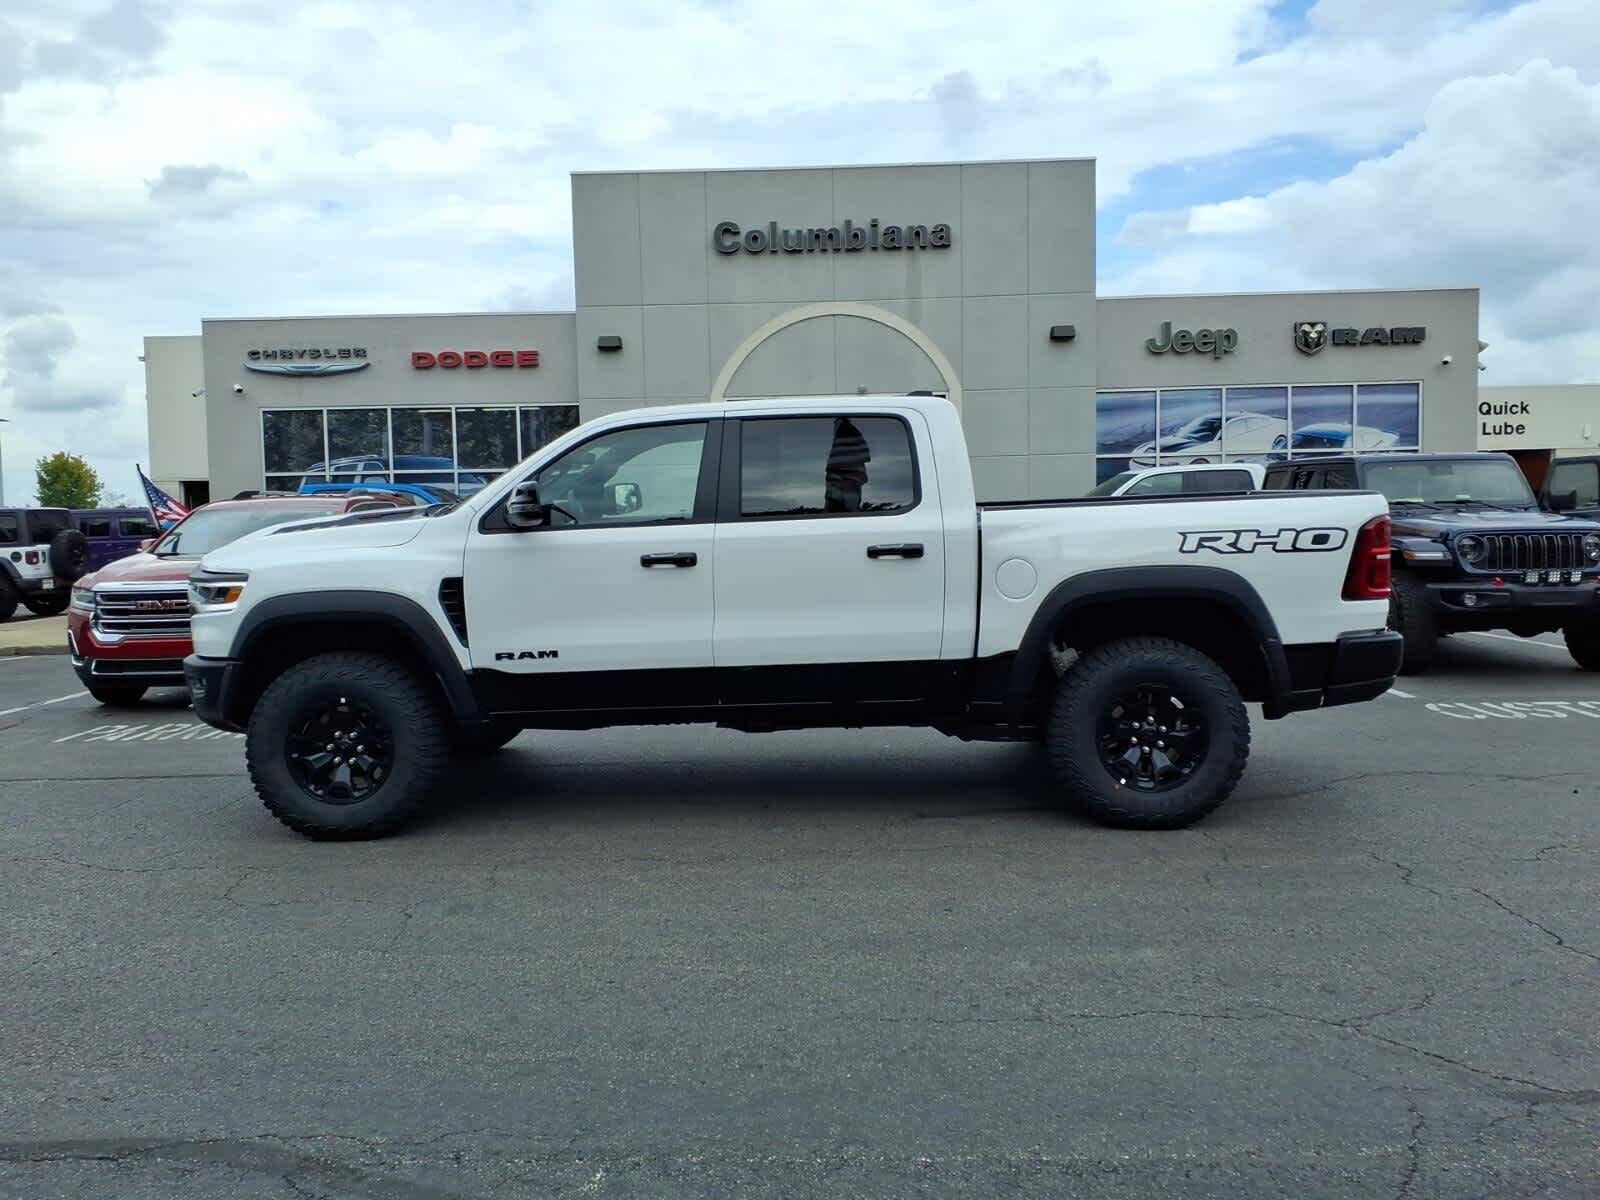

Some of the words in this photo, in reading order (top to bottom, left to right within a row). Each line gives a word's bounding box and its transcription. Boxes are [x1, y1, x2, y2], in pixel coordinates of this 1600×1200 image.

[713, 218, 952, 254] Columbiana
[1146, 321, 1238, 359] Jeep
[1332, 326, 1426, 347] RAM
[247, 348, 368, 360] CHRYSLER
[411, 350, 539, 369] DODGE
[1478, 401, 1530, 415] Quick
[1482, 422, 1526, 436] Lube
[1177, 527, 1349, 554] RHO
[495, 650, 559, 661] RAM
[1425, 701, 1600, 719] CUST
